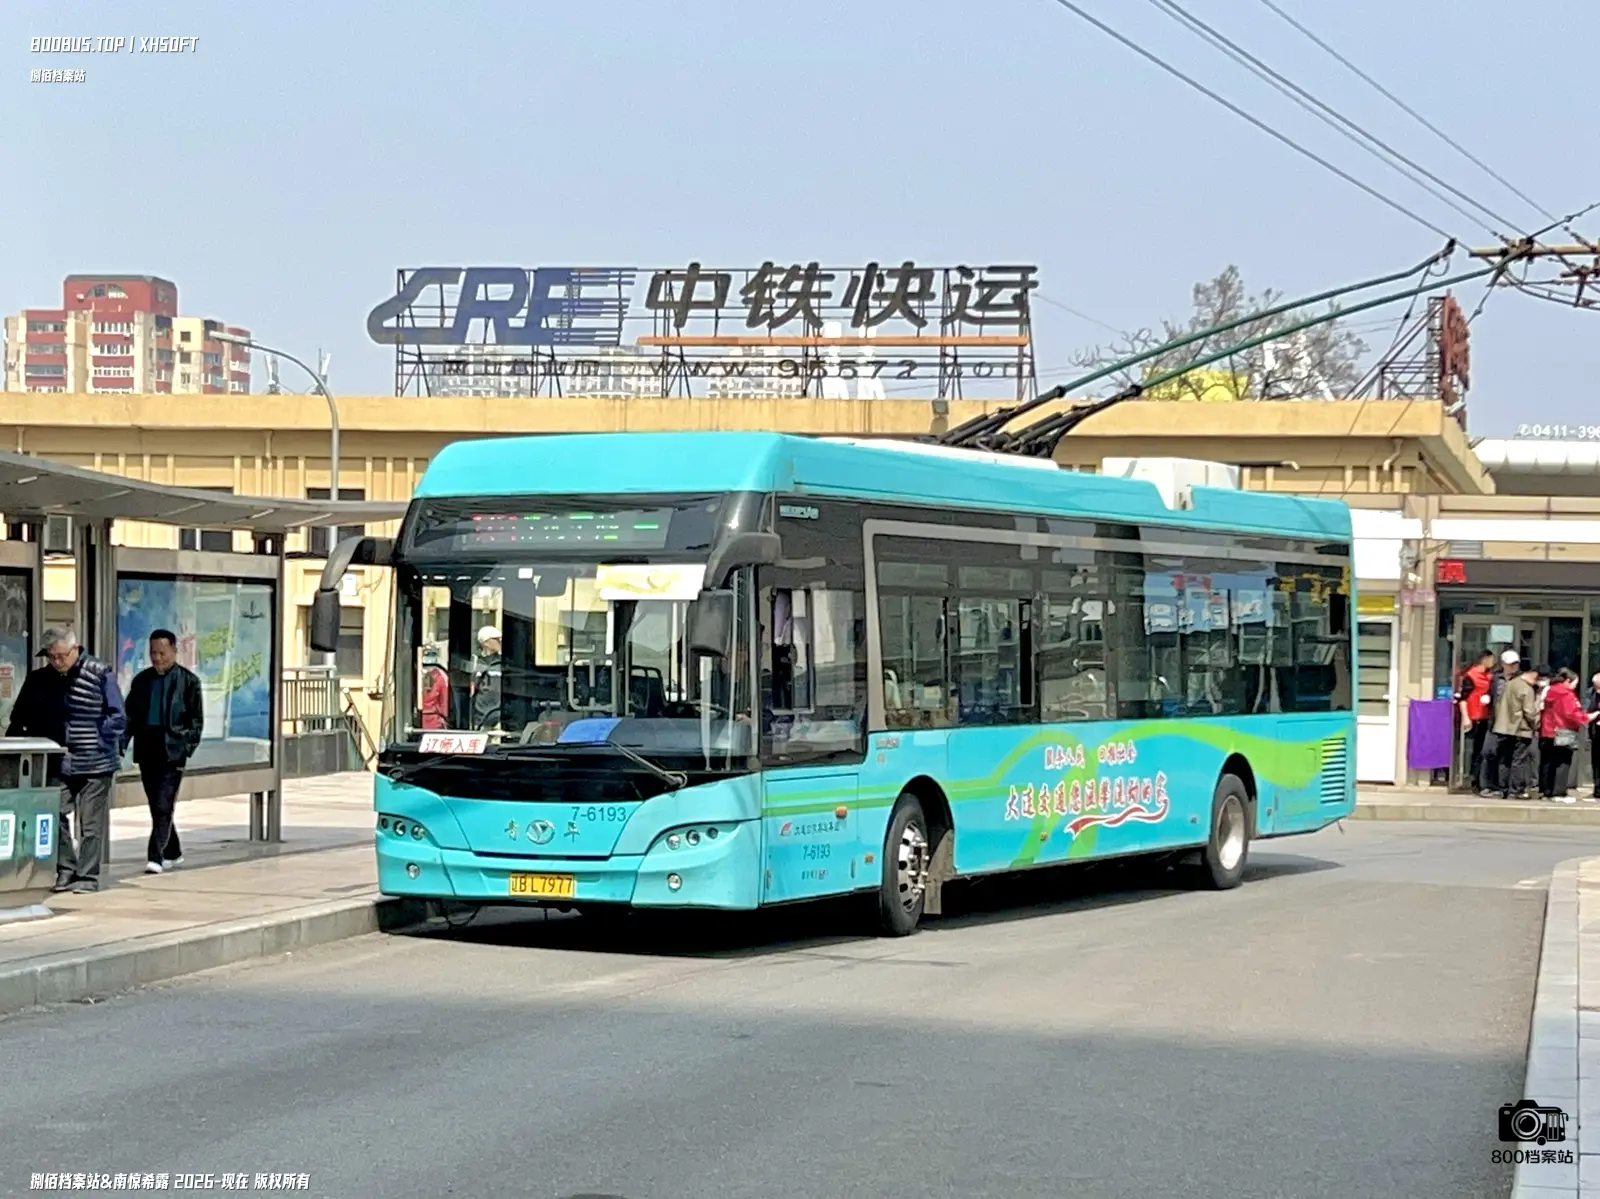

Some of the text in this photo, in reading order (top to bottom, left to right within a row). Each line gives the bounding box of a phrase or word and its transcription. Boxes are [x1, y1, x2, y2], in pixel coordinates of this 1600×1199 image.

[645, 261, 1039, 328] 中铁快运
[571, 806, 627, 822] 7-6193
